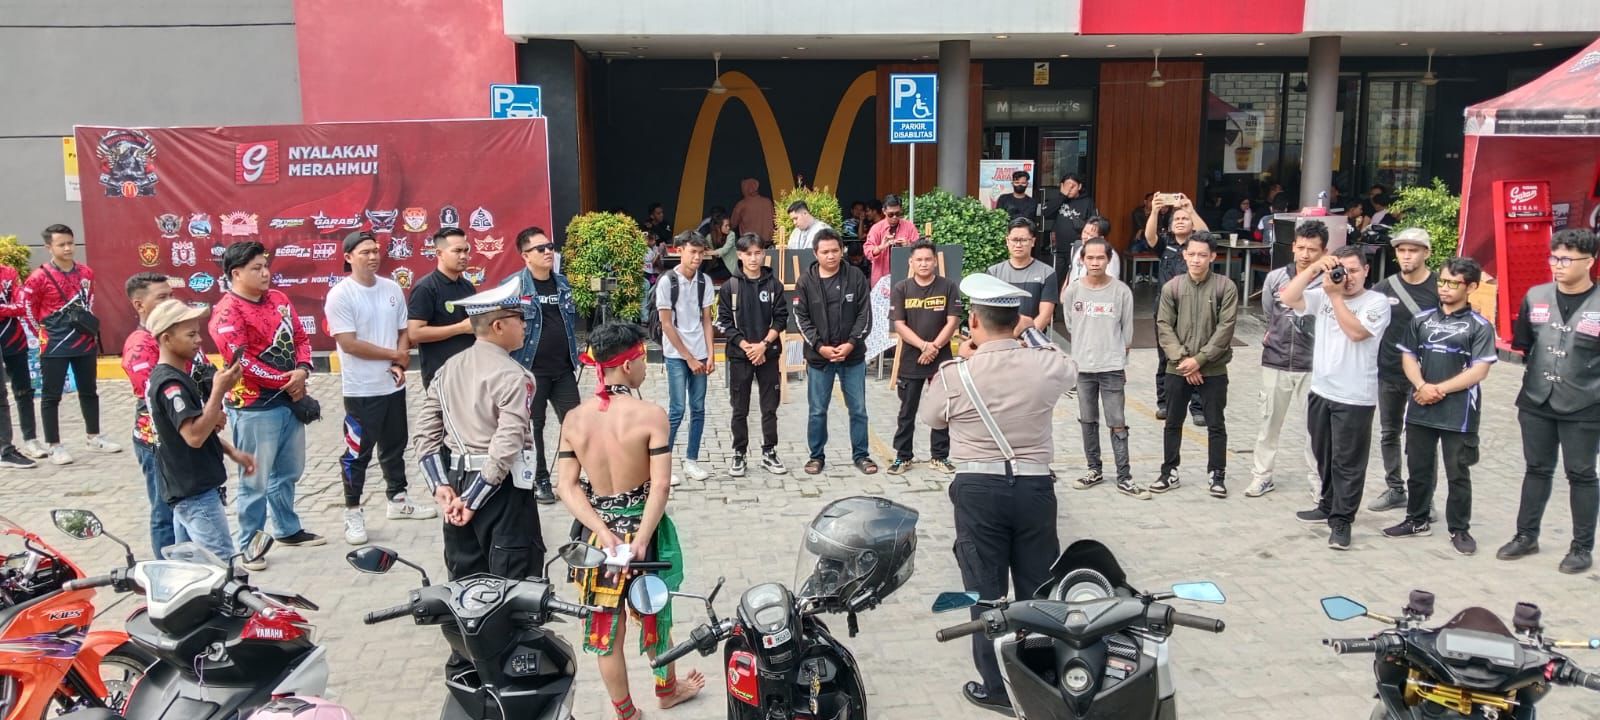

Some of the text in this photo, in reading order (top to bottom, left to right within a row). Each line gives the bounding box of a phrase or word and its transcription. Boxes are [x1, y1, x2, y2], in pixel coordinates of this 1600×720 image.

[494, 88, 514, 113] P
[895, 78, 917, 108] P
[901, 122, 927, 130] PARKIR
[894, 131, 933, 139] DISABILITAS
[288, 144, 378, 160] NYALAKAN
[288, 161, 378, 177] MERAHMU!
[255, 627, 284, 639] YAMAHA
